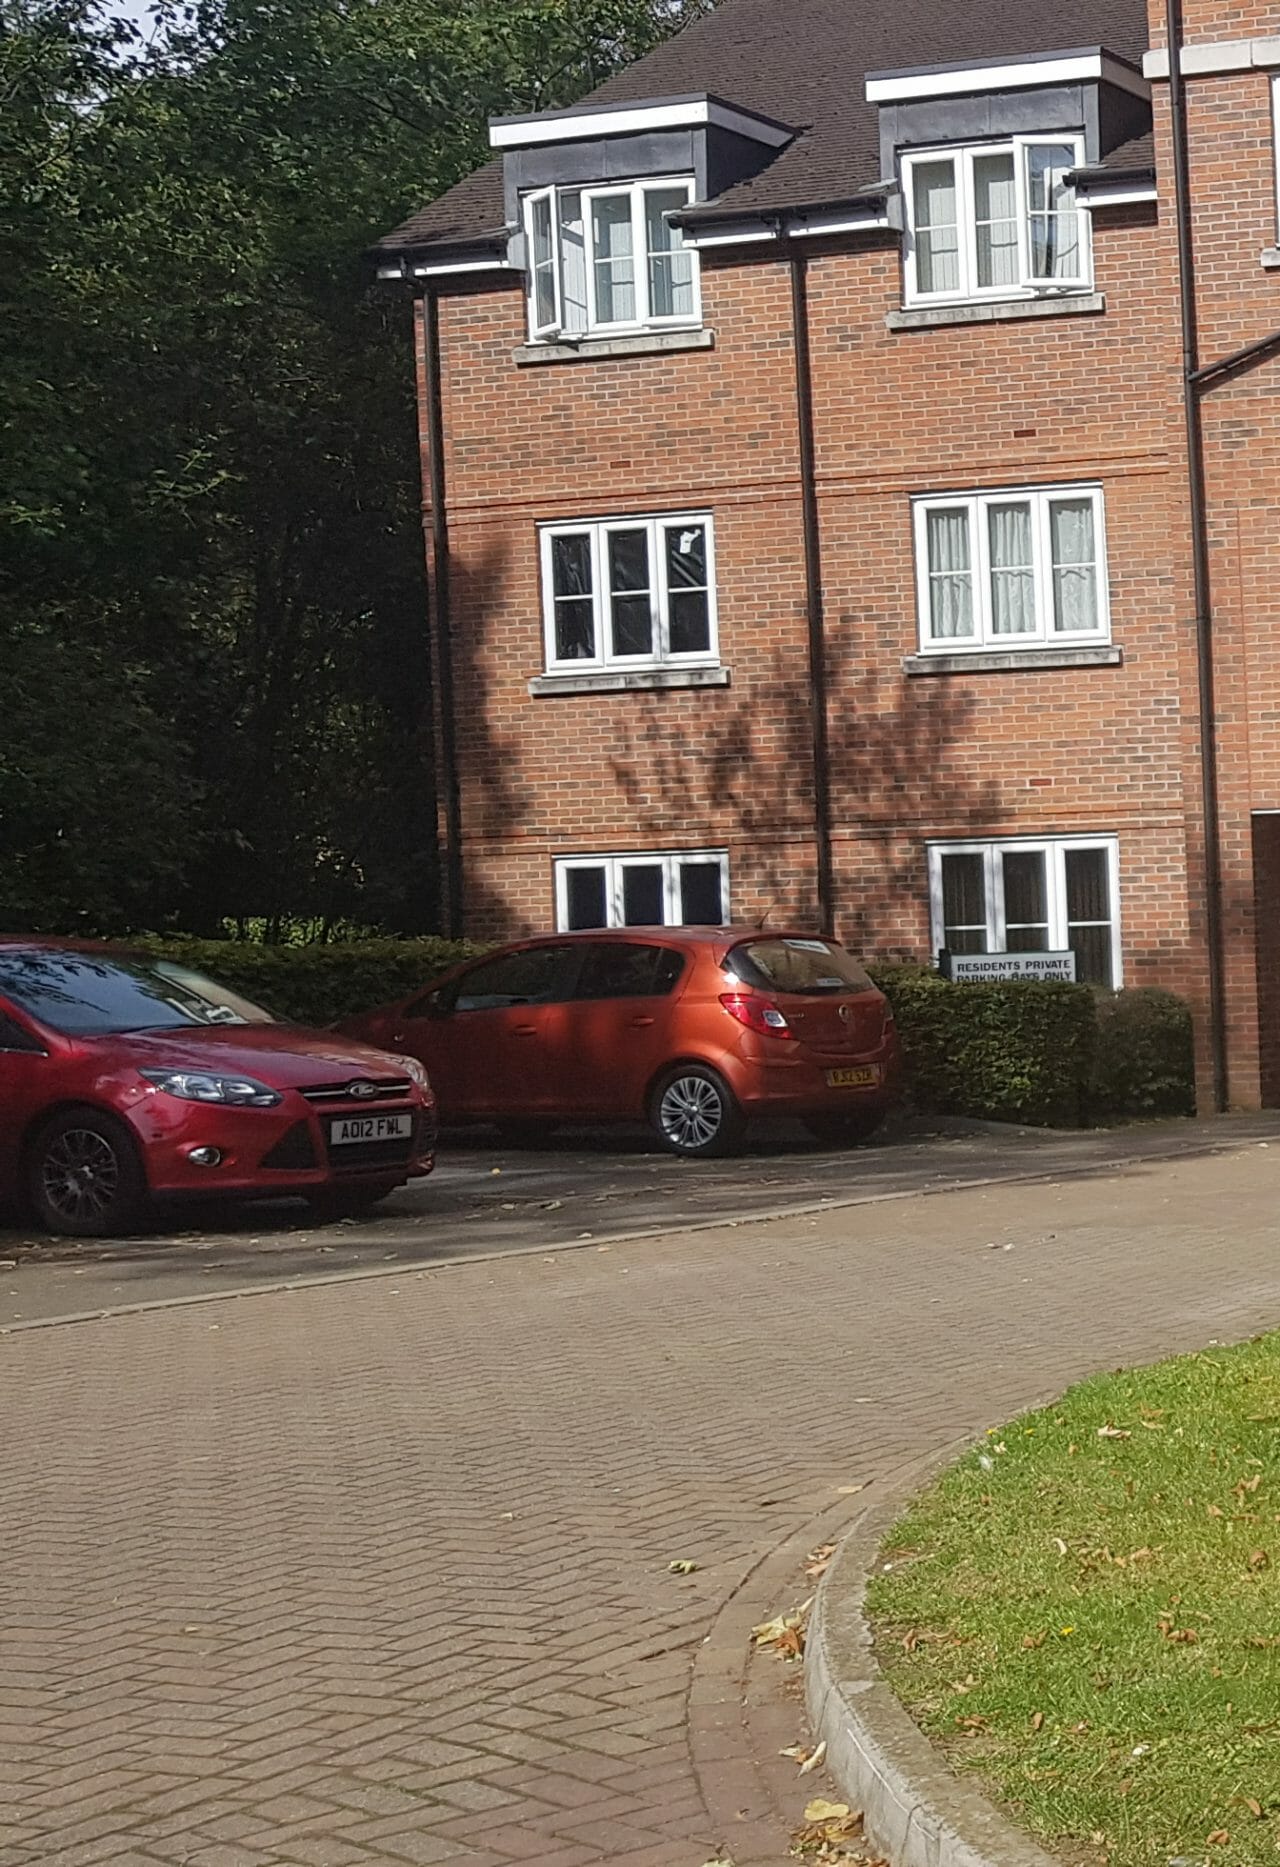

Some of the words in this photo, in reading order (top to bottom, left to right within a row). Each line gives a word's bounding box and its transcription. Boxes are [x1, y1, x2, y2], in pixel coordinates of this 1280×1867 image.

[957, 961, 1021, 972] RESIDENTS
[1025, 959, 1071, 970] PRIVATE
[1044, 971, 1072, 981] ONLY
[377, 1117, 404, 1136] FWL
